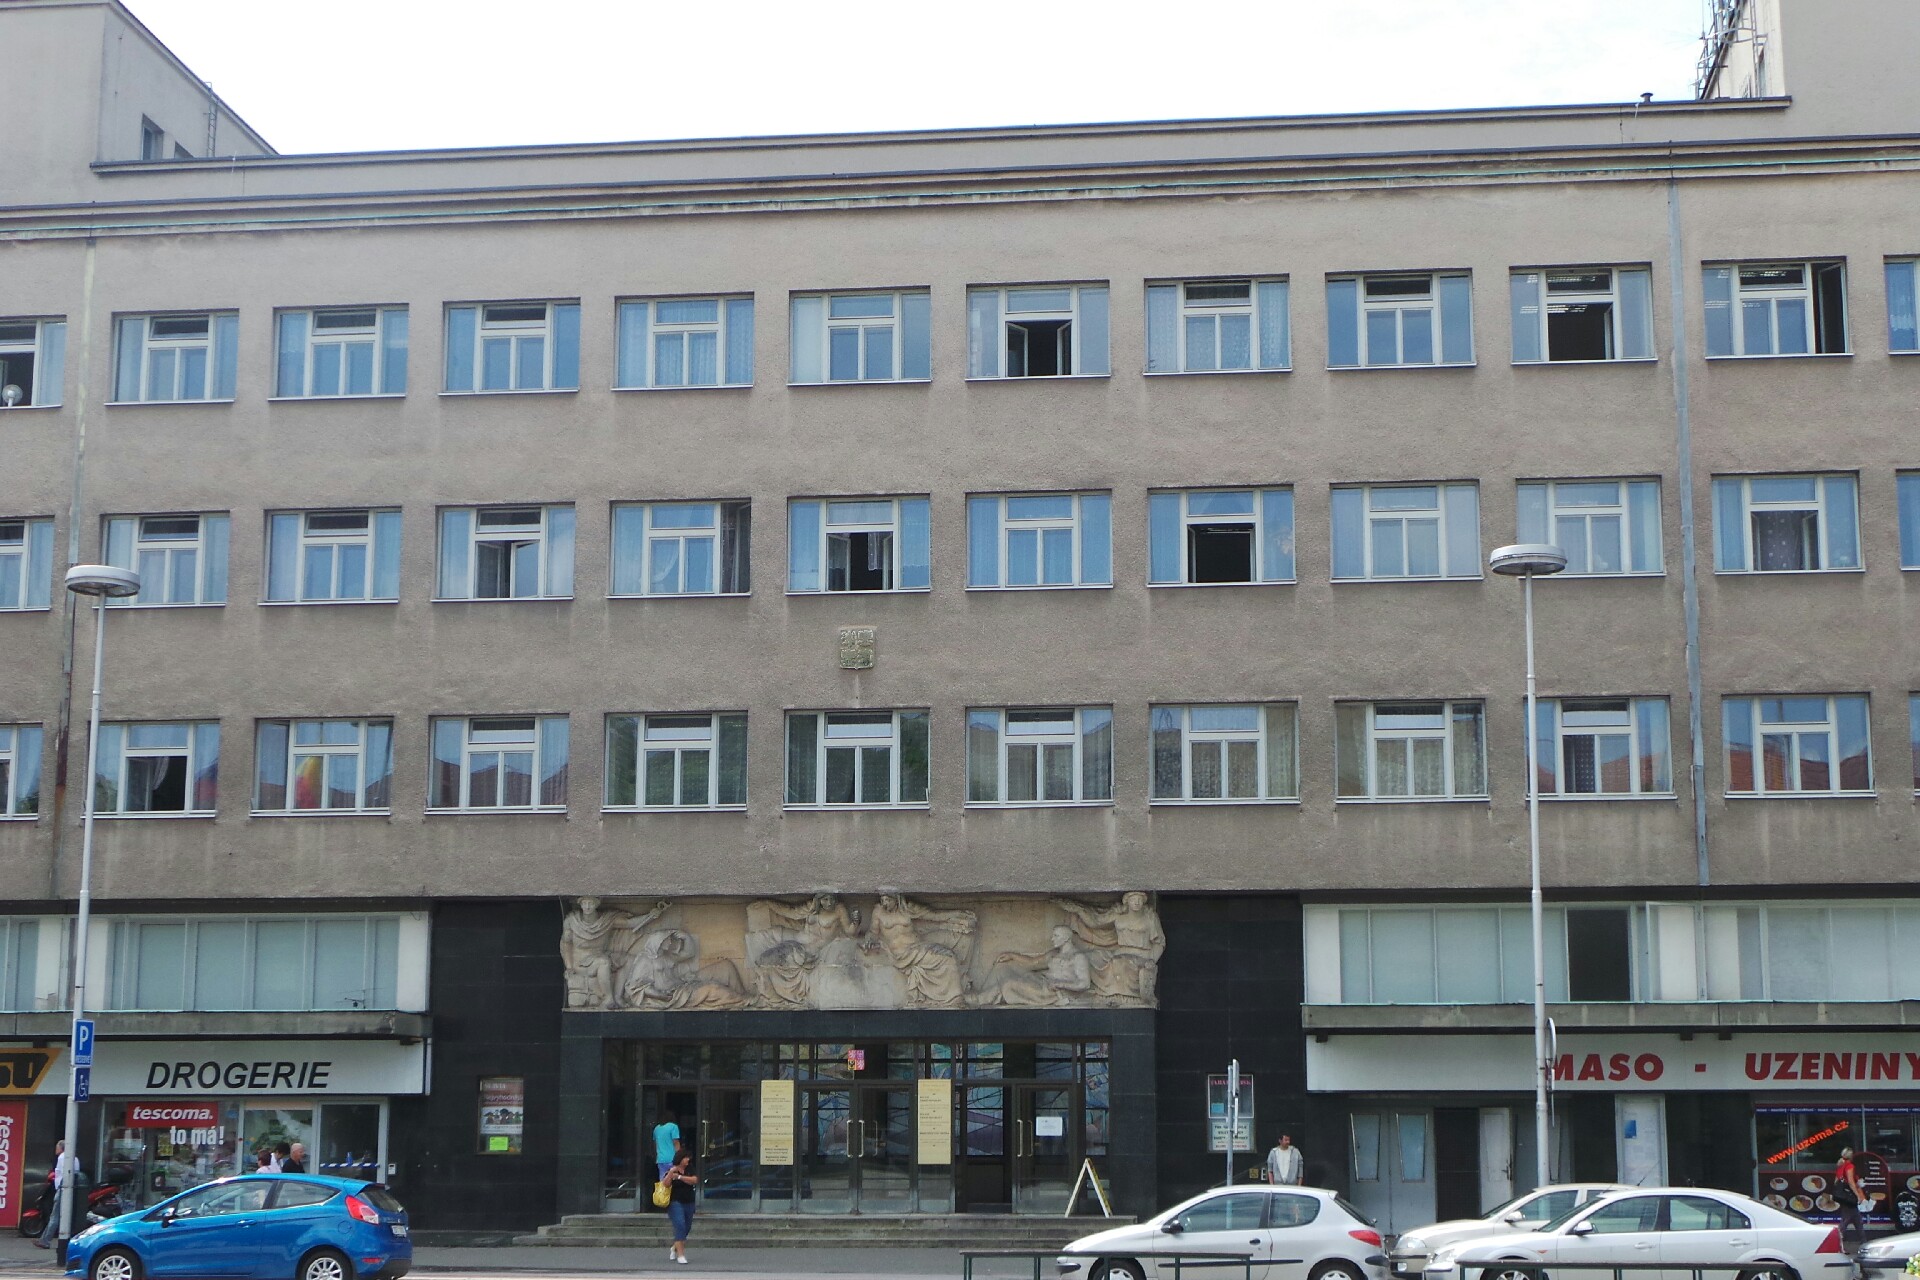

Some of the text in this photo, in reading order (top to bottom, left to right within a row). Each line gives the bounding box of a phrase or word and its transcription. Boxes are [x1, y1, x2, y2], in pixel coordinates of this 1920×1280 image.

[79, 1025, 89, 1051] P
[146, 1061, 332, 1088] DROGERIE
[1545, 1053, 1664, 1081] MASO
[1745, 1052, 1920, 1080] UZENINY
[132, 1106, 214, 1120] tescoma.
[170, 1125, 225, 1145] to má!
[1767, 1120, 1849, 1165] www.uzema.cz
